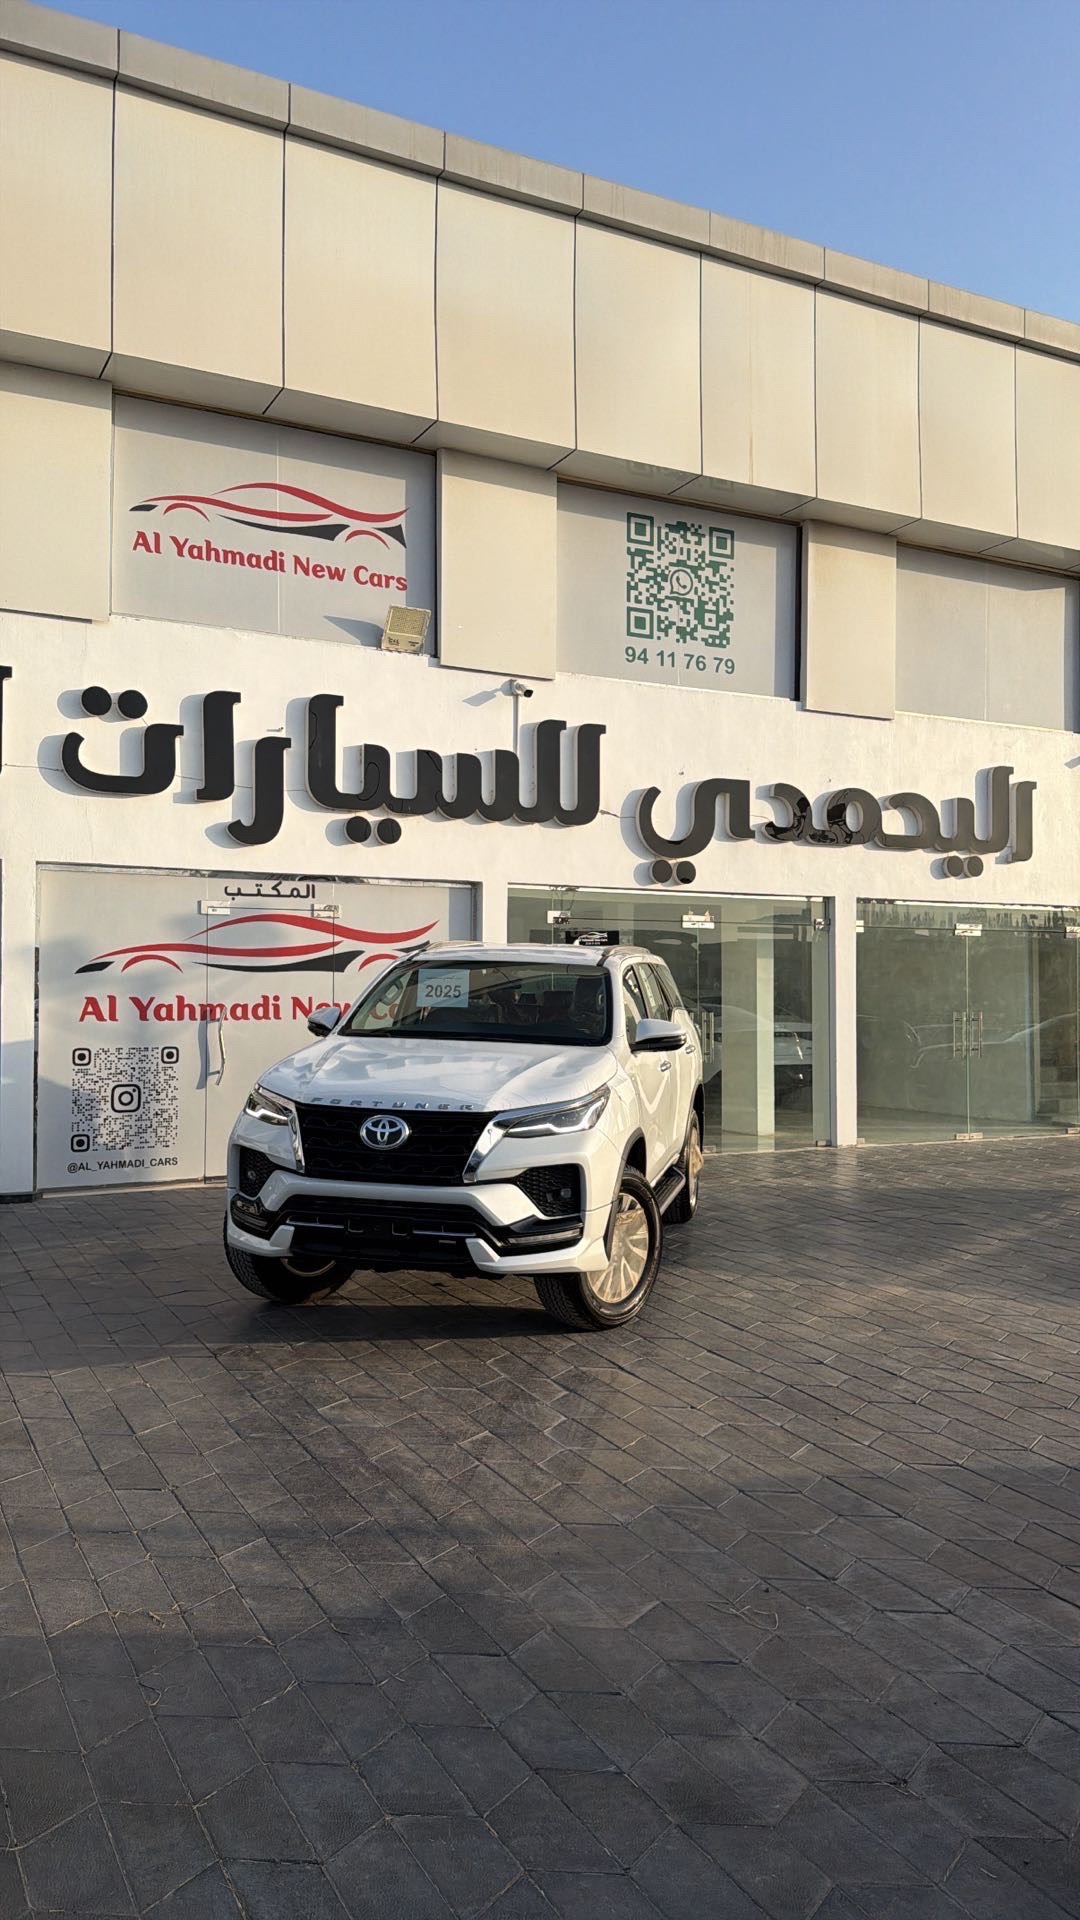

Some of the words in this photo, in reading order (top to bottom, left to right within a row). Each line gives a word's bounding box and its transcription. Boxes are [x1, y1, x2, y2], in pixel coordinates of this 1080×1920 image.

[133, 530, 162, 554] Al
[169, 535, 286, 573] Yahmadi
[292, 554, 346, 582] New
[353, 565, 408, 591] Cars
[624, 646, 649, 665] 94
[656, 650, 675, 668] 11
[683, 653, 707, 671] 76
[713, 656, 735, 675] 79
[61, 686, 607, 845] للسيارات
[638, 766, 1037, 885] اليحمدي
[223, 881, 316, 901] المكتب
[425, 984, 462, 999] 2025
[79, 995, 119, 1022] Al
[129, 995, 282, 1022] Yahmadi
[311, 1097, 475, 1111] FORTUNER
[67, 1157, 178, 1174] @AL_YAHMADI_CARS
